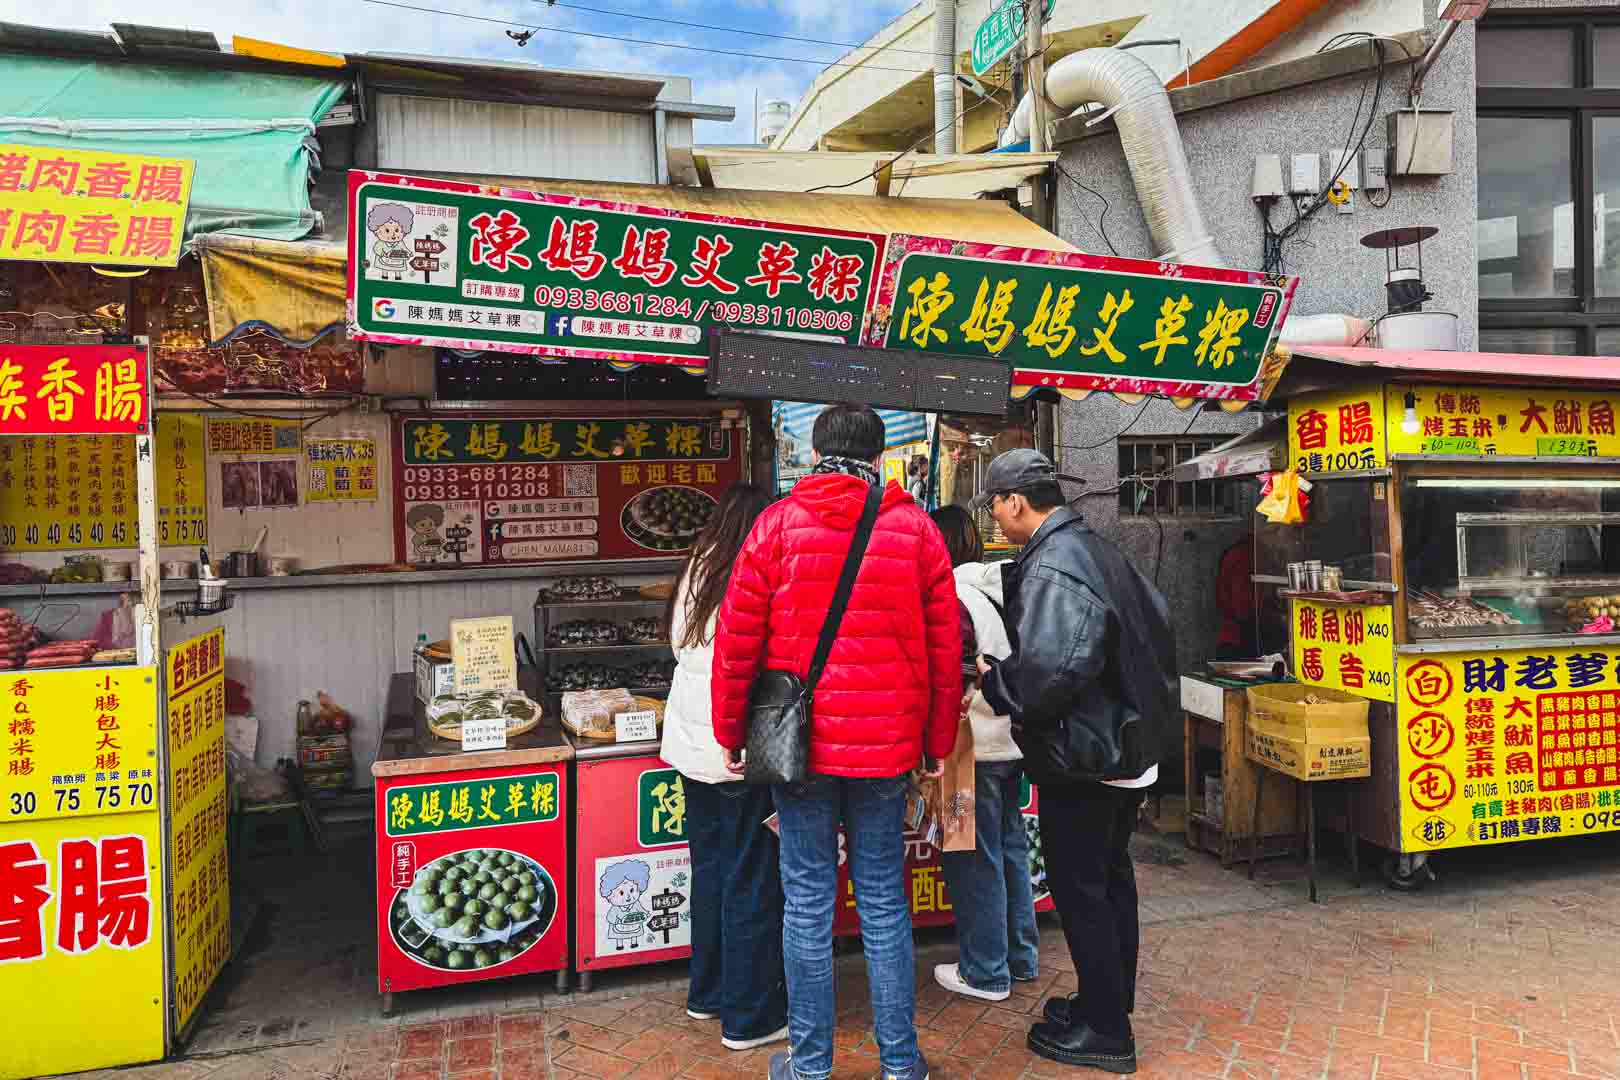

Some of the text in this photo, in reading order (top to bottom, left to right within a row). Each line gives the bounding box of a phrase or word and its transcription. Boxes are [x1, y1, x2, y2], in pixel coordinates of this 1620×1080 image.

[0, 208, 176, 258] 肉香腸
[468, 209, 864, 304] 陳媽媽艾草粿
[465, 280, 521, 299] 訂購專線
[408, 304, 522, 328] 陳媽媽艾草粿
[581, 319, 686, 341] 陳媽媽艾草粿
[898, 270, 1250, 369] 陳媽媽艾草粿
[1434, 393, 1481, 415] 傳統
[1519, 399, 1617, 436] 大魷魚
[412, 420, 703, 461] 陳媽媽艾草粿
[1296, 400, 1374, 451] 香腸
[1423, 415, 1493, 438] 烤玉米
[403, 465, 551, 484] 0933-681284
[403, 482, 550, 501] 0933-110308
[618, 463, 719, 487] 歡迎宅配
[25, 524, 39, 545] 40
[48, 523, 60, 545] 40
[69, 523, 82, 544] 45
[91, 522, 104, 544] 40
[112, 522, 126, 544] 45
[175, 519, 188, 540] 75
[1299, 606, 1389, 647] 飛魚卵 X40
[173, 633, 220, 690] 台灣香腸
[1301, 647, 1391, 689] 馬告 X40
[1462, 652, 1620, 693] 財老爹
[1540, 693, 1616, 713] 黑豬肉香腸
[94, 675, 121, 770] 小腸包大腸
[1464, 697, 1496, 780] 傳統烤玉米
[1504, 696, 1535, 776] 大魷魚
[51, 773, 86, 786] 飛魚卵
[128, 767, 153, 780] 原味
[1464, 781, 1499, 799] 60-110元
[1506, 779, 1535, 795] 130元
[10, 781, 153, 815] 30 75 75 70
[390, 779, 555, 831] 陳媽媽艾草粿
[1422, 819, 1446, 842] 老店
[396, 845, 411, 886] 純手工
[911, 866, 953, 914] 配
